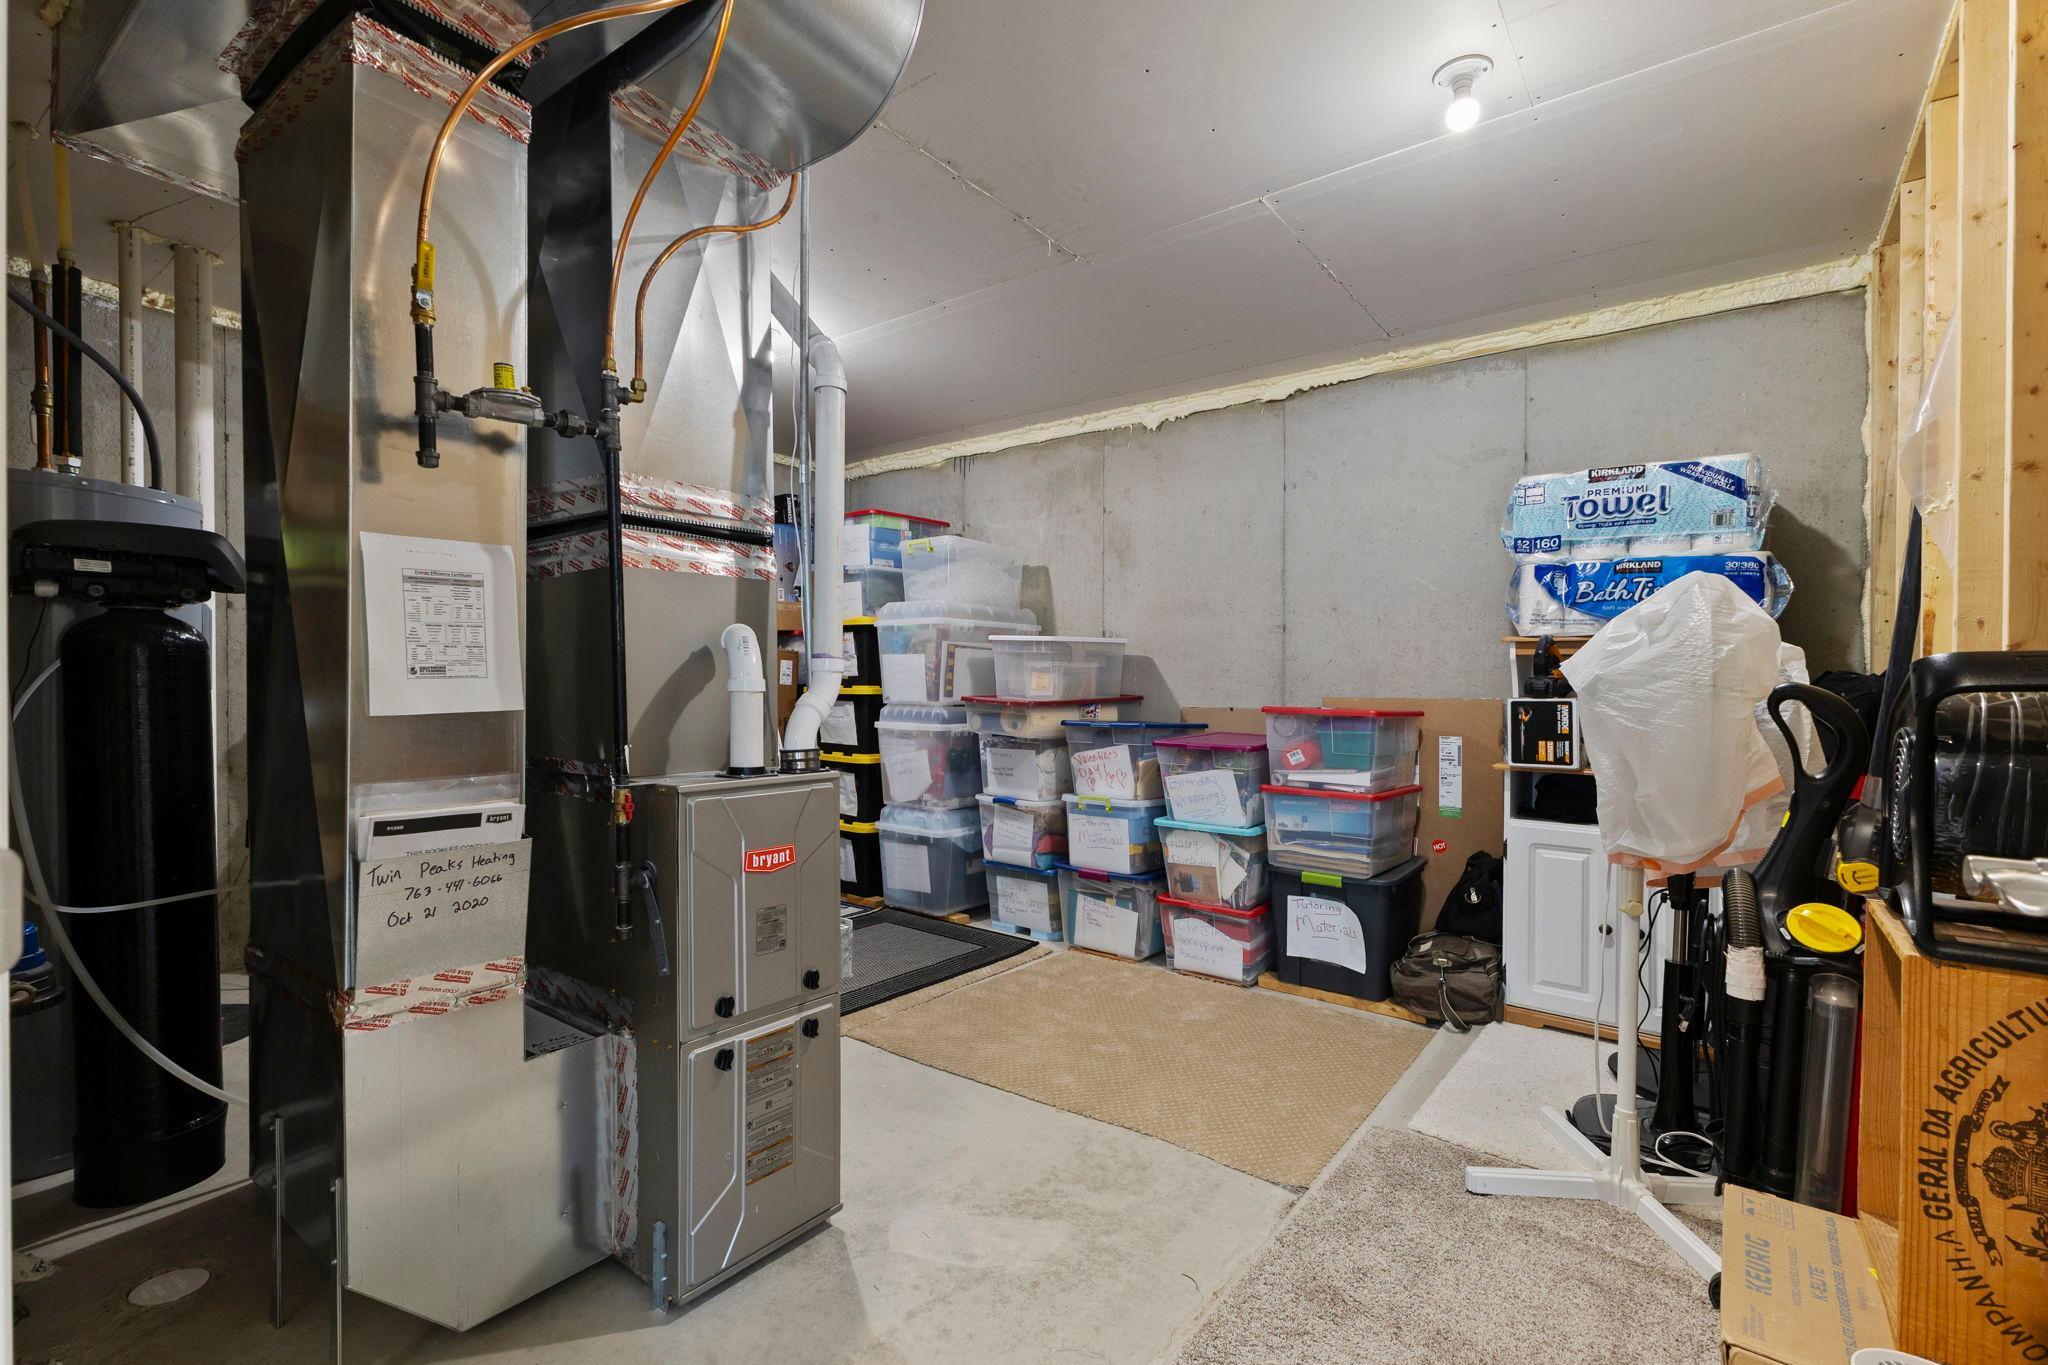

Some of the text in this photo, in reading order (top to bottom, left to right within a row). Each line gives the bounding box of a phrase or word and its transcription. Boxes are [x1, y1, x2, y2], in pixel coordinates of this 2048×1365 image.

[1591, 466, 1644, 477] KIRKLAND
[1680, 467, 1735, 491] WRAPPED ROLLS
[1688, 464, 1734, 484] INDIVIDUALLY
[1563, 485, 1671, 520] Towel
[1587, 485, 1647, 498] PREMIUM
[1517, 538, 1559, 549] 12 160
[1616, 560, 1662, 570] KIRKLAND
[1575, 578, 1633, 604] Bath
[1073, 751, 1118, 765] Valentines
[489, 814, 510, 823] bryant
[752, 849, 791, 868] bryant
[1433, 843, 1446, 851] HOT
[367, 851, 515, 887] Twin Peaks Heating
[387, 896, 489, 928] Oct 21 2020
[1292, 898, 1342, 915] Tutoring
[1296, 915, 1357, 939] Materials
[1935, 997, 2048, 1105] AGRICULTU
[1921, 1108, 1953, 1140] DA
[1918, 1146, 1953, 1221] GERAL
[1744, 1231, 1774, 1297] KEURIG
[1808, 1262, 1829, 1303] K-ELITE
